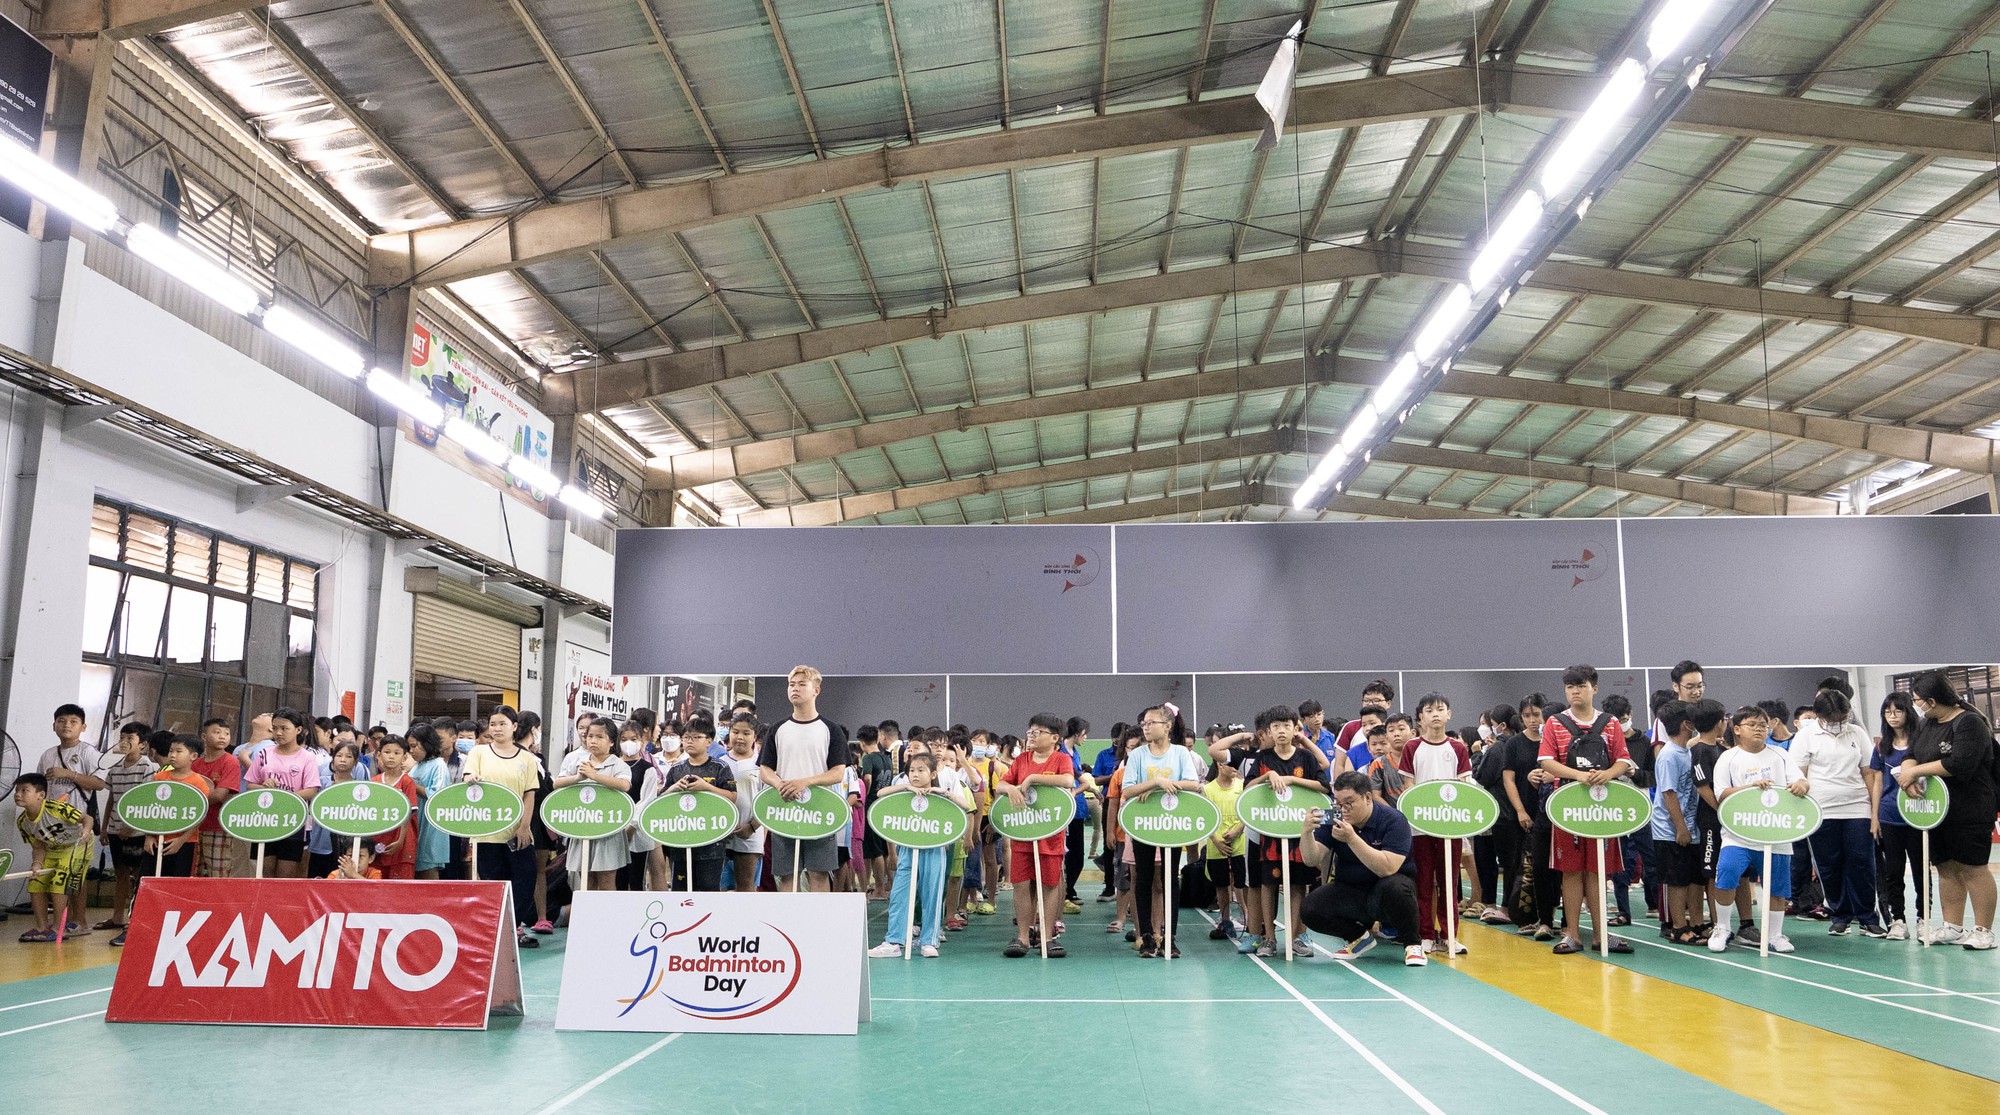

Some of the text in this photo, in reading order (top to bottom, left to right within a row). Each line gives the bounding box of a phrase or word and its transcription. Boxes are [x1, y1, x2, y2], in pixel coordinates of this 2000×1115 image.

[581, 689, 604, 710] BÌNH
[667, 684, 679, 698] JUST
[666, 699, 675, 712] DO
[125, 803, 197, 820] PHƯỜNG 15
[320, 804, 399, 821] PHƯỜNG 13
[436, 804, 513, 822] PHƯỜNG 12
[551, 806, 624, 824] PHƯỜNG 11
[766, 806, 834, 826] PHƯỜNG 9
[1054, 806, 1061, 821] 7
[1251, 804, 1307, 822] PHƯỜNG
[1413, 804, 1484, 823] PHƯỜNG 4
[1563, 804, 1637, 822] PHƯỜNG 3
[1935, 800, 1940, 814] 1
[228, 811, 298, 828] PHƯỜNG 14
[650, 815, 728, 833] PHƯỜNG 10
[882, 814, 953, 836] PHƯỜNG 8
[1134, 812, 1192, 831] PHƯỜNG
[1195, 816, 1206, 831] 6
[1733, 810, 1806, 829] PHƯỜNG 2
[1704, 829, 1713, 863] adidas
[148, 910, 458, 992] KAMITO
[698, 936, 760, 954] World
[668, 954, 785, 973] Badminton
[704, 975, 747, 998] Day
